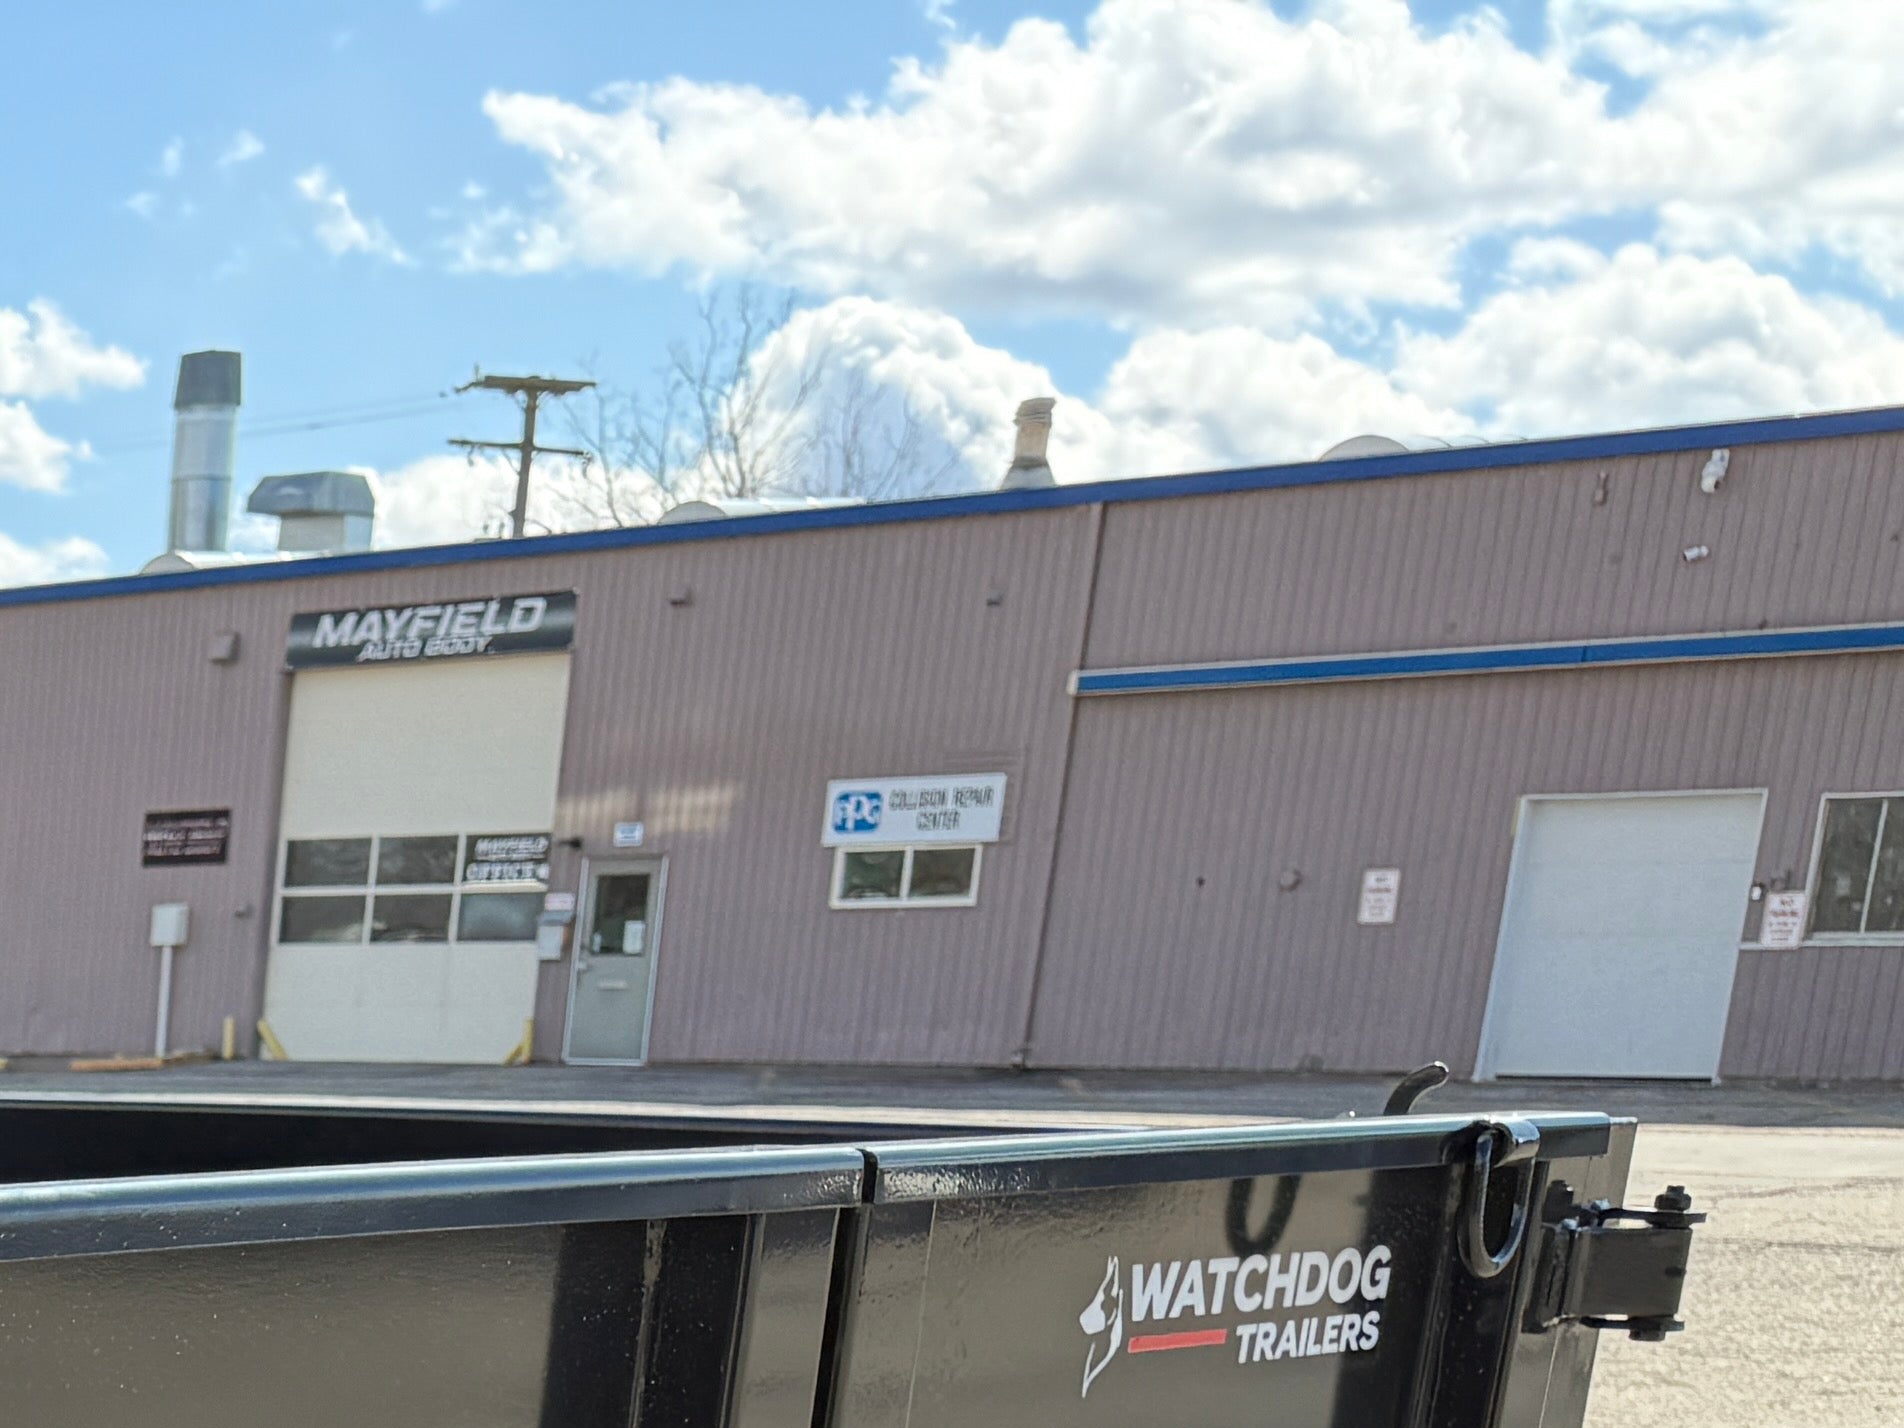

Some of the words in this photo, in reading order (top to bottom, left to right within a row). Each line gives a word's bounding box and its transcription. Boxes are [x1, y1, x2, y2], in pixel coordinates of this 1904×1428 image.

[312, 597, 547, 648] MAYFIELD
[356, 638, 423, 663] AUTO
[424, 635, 493, 657] BODY
[834, 793, 882, 832] PPG
[1131, 1245, 1391, 1322] WATCHDOG
[1236, 1310, 1380, 1364] TRAILERS
